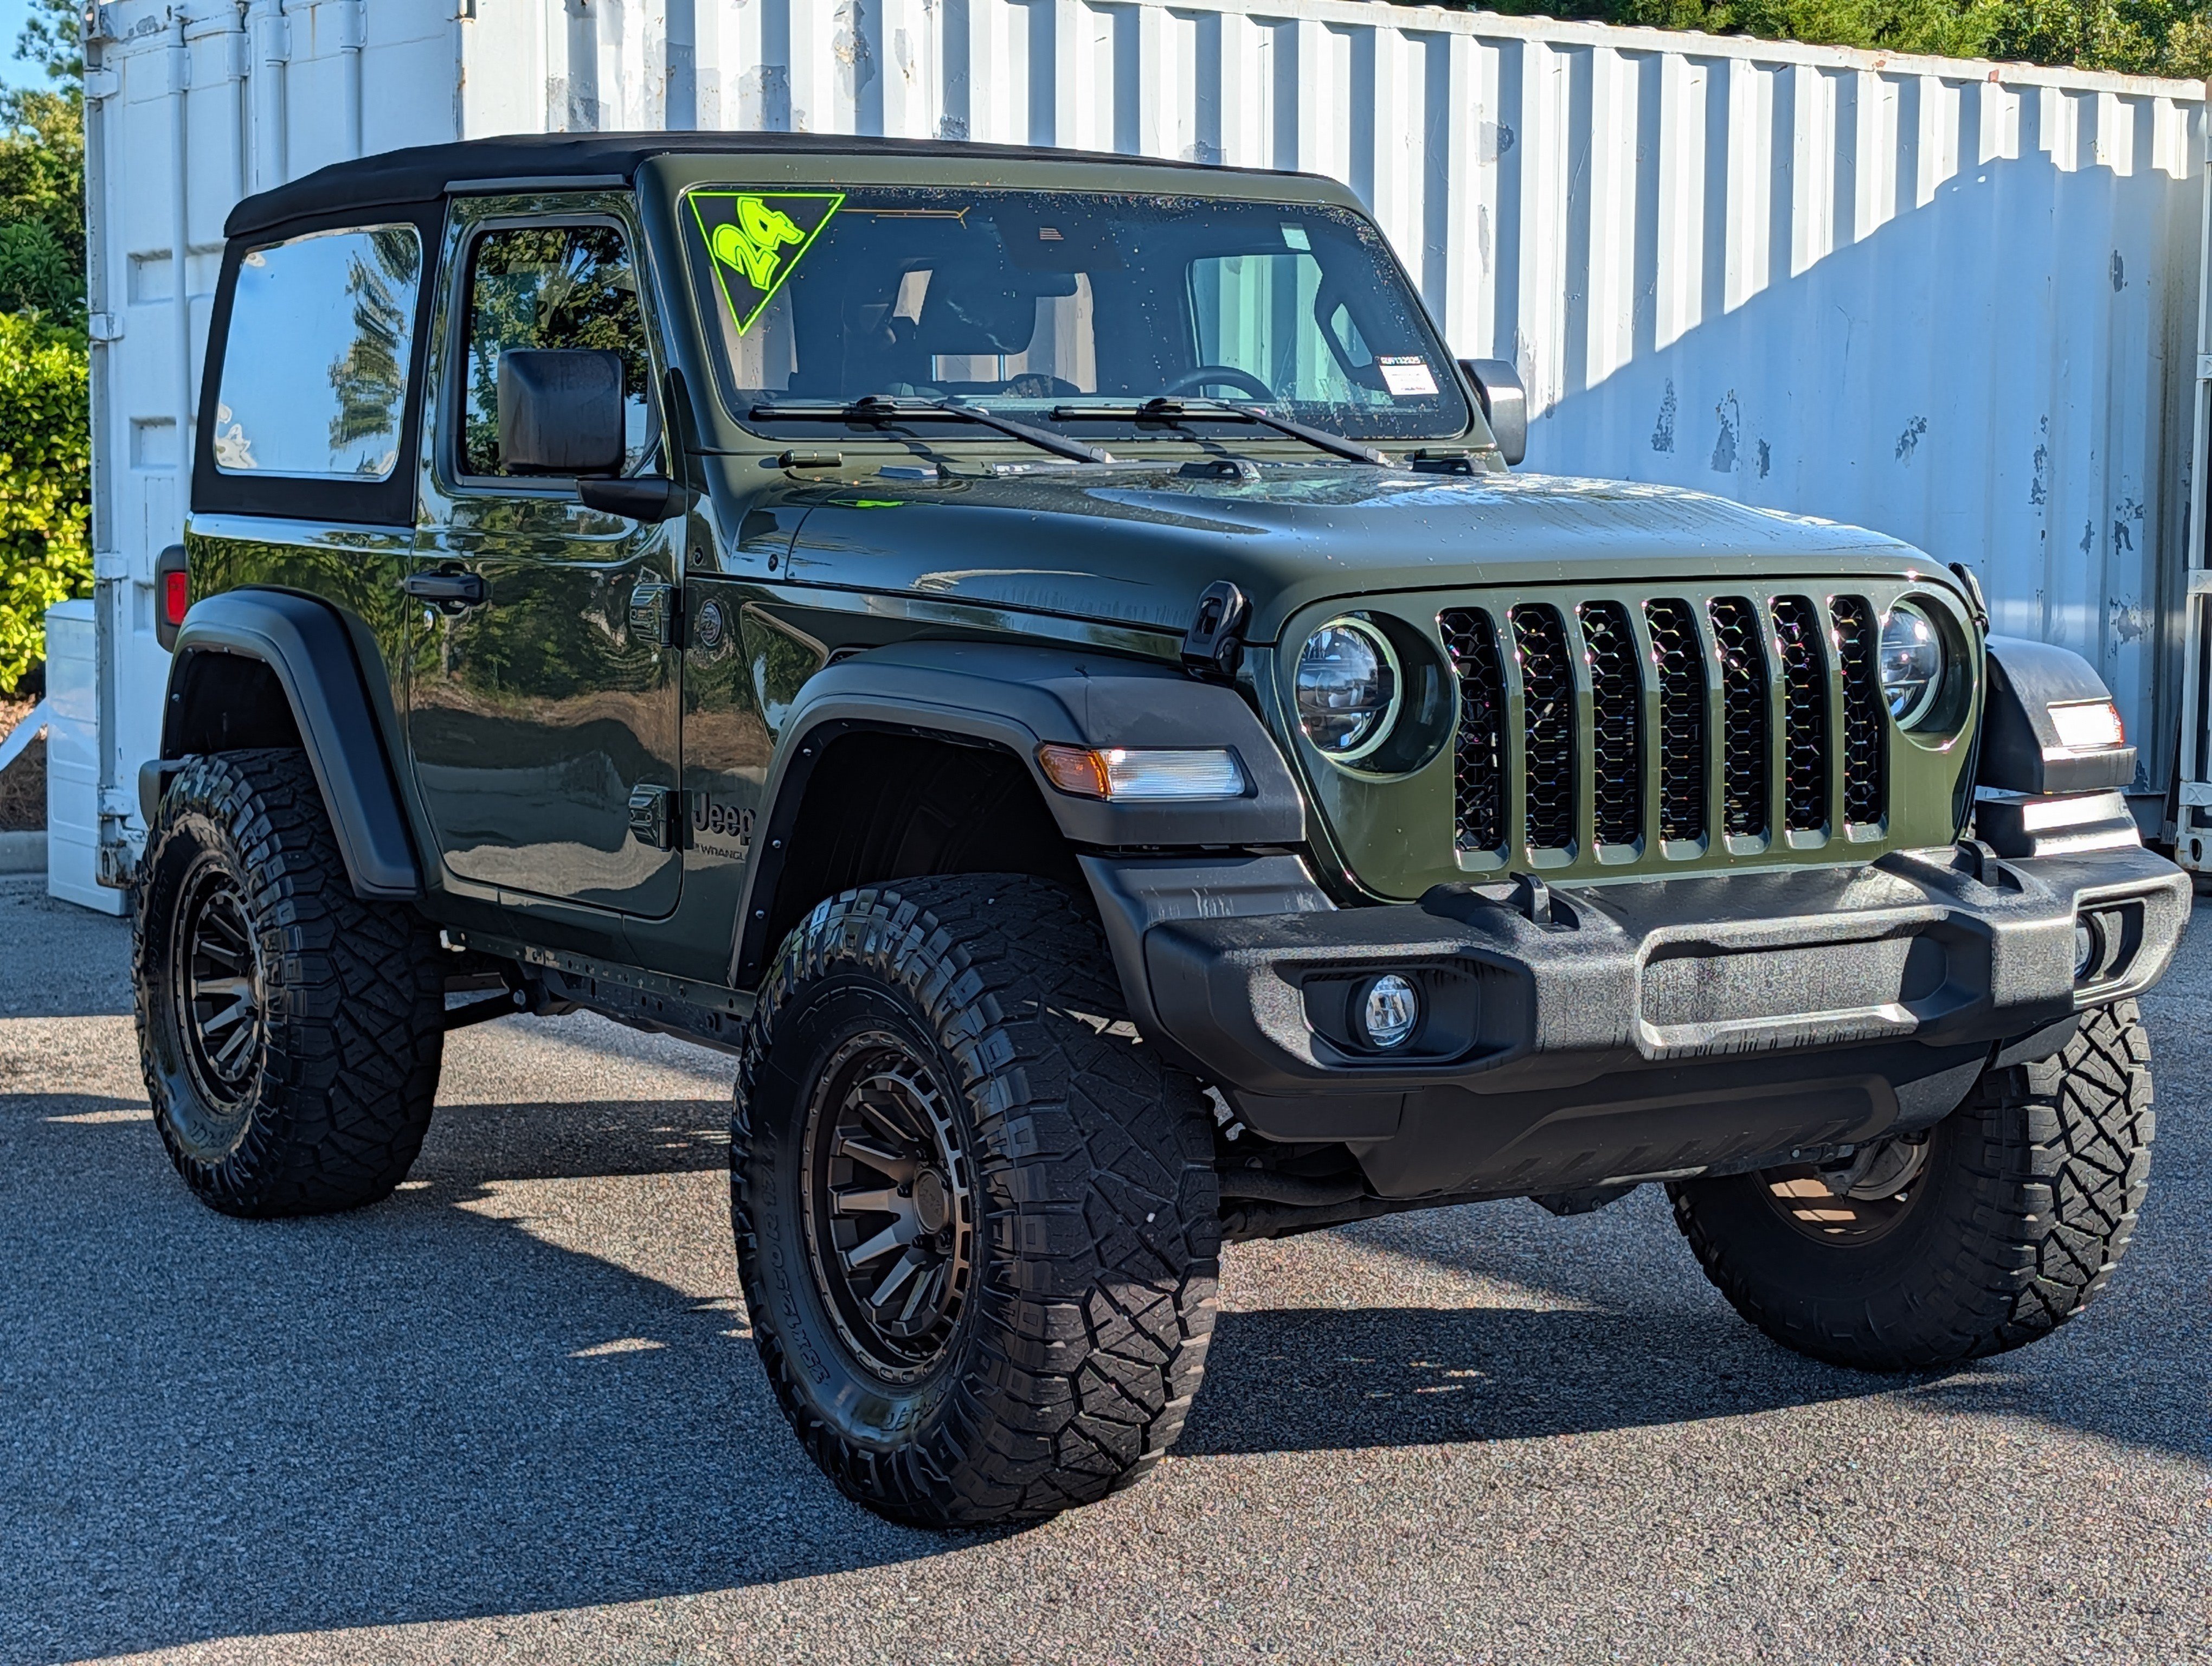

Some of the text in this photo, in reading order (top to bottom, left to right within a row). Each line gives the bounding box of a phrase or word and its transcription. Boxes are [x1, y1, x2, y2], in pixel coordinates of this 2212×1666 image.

[712, 196, 806, 291] 24
[691, 792, 757, 846] Jeep
[700, 843, 745, 861] WRANGL
